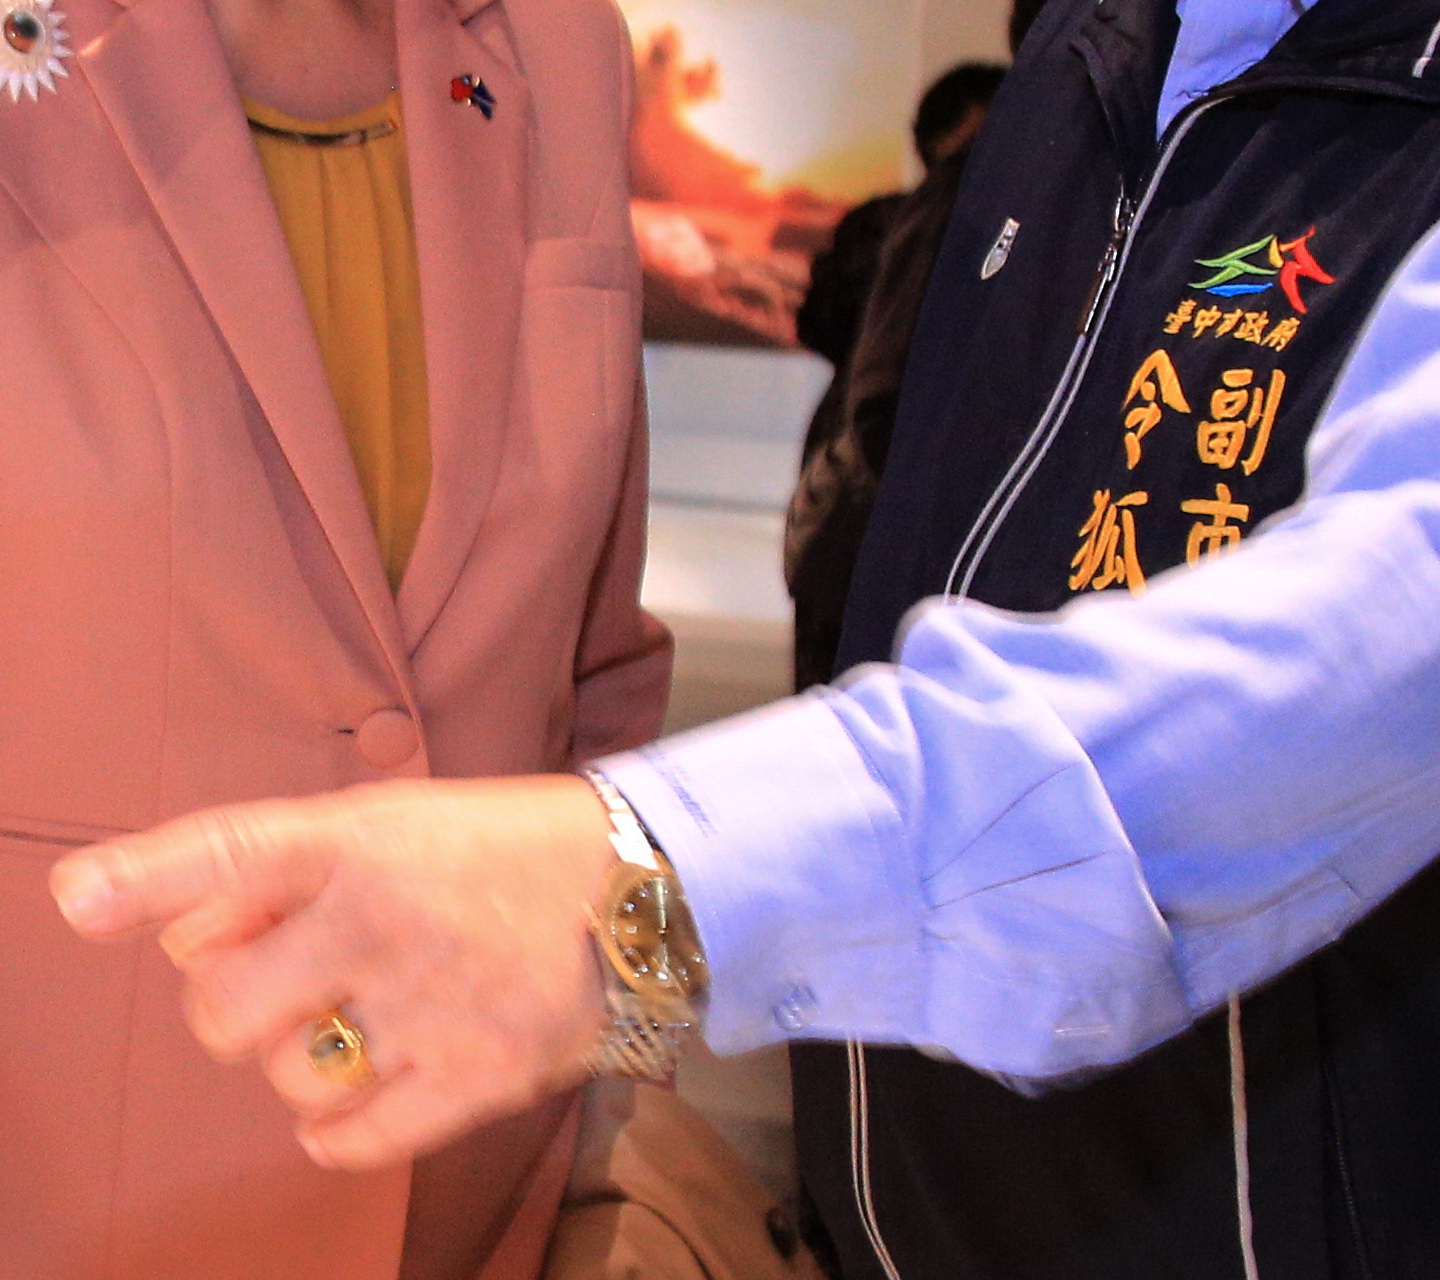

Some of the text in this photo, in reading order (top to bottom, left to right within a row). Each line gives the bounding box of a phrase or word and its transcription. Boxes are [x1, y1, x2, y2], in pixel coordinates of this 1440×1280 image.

[1162, 298, 1301, 353] 臺中市政府
[1069, 348, 1192, 599] 令狐
[1180, 368, 1287, 571] 副市
